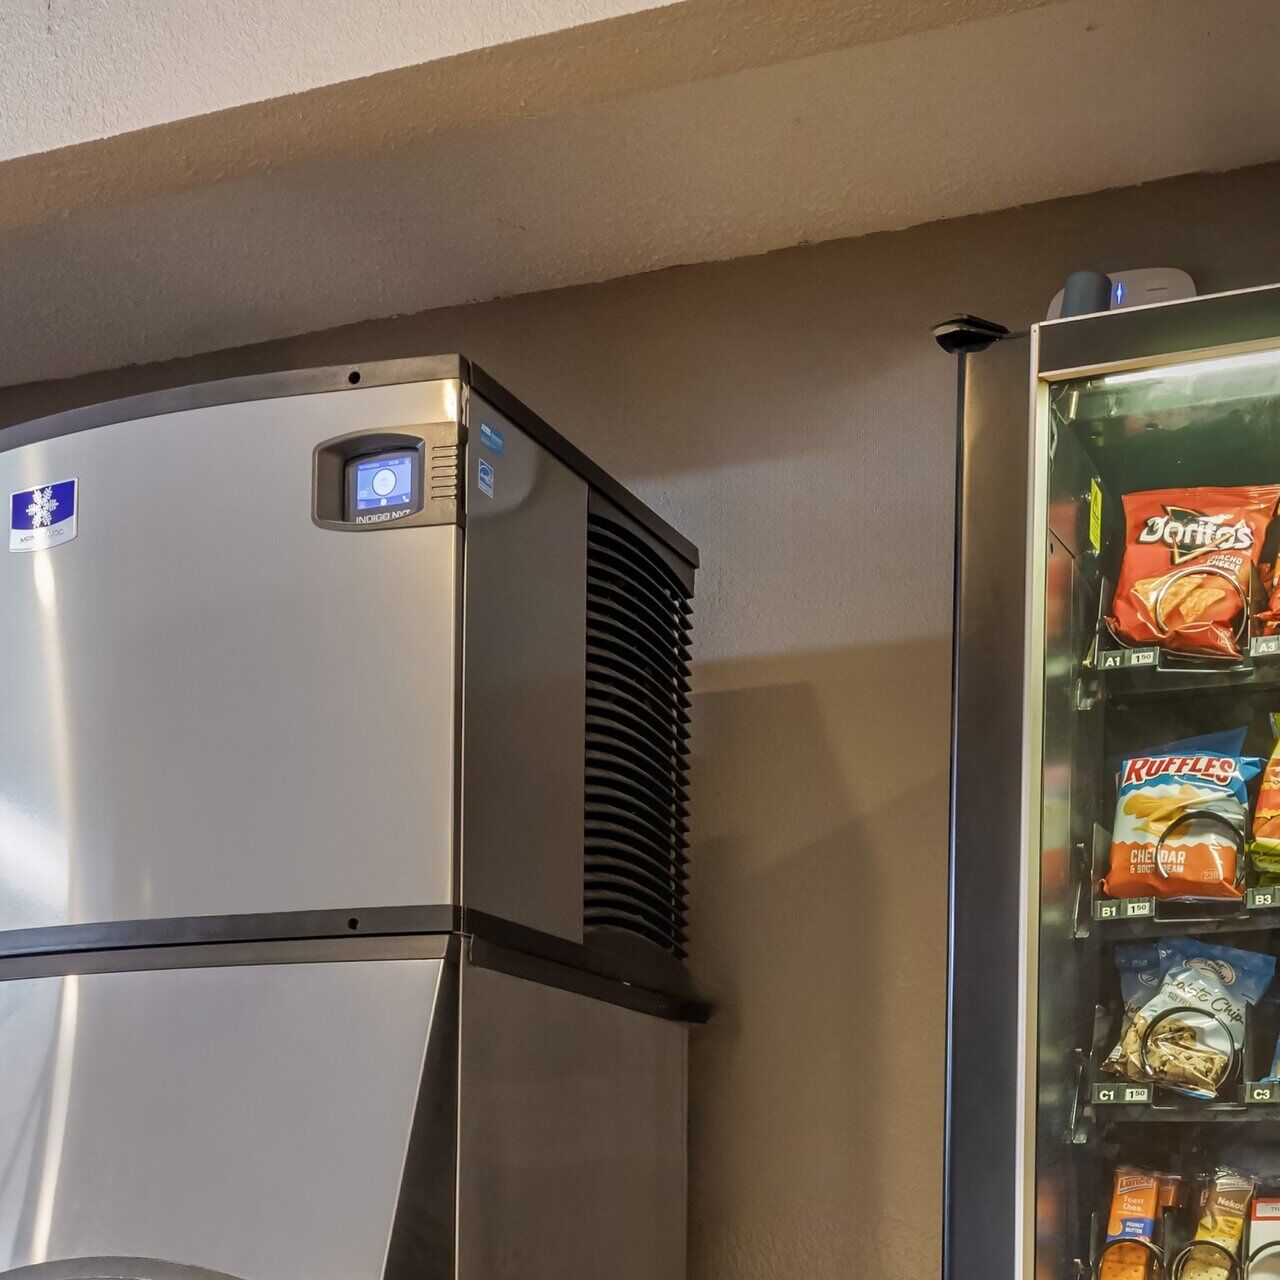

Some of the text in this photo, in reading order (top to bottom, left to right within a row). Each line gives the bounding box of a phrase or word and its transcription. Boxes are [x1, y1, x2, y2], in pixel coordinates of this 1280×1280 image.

[356, 513, 390, 525] INDIGO
[1137, 514, 1256, 551] Doritos
[1206, 558, 1243, 572] CHEESE
[1209, 554, 1244, 566] NACHO
[1259, 643, 1276, 653] A3
[1105, 657, 1121, 667] A1
[1124, 757, 1236, 786] RUFFLES
[1255, 895, 1272, 906] B3
[1102, 906, 1117, 917] B1
[1210, 997, 1244, 1025] Chip
[1099, 1090, 1115, 1100] C1
[1253, 1088, 1271, 1099] C3
[1119, 1176, 1153, 1188] Lance
[1123, 1195, 1144, 1204] Toast
[1217, 1197, 1245, 1211] Nekot
[1125, 1221, 1145, 1229] PEANUT
